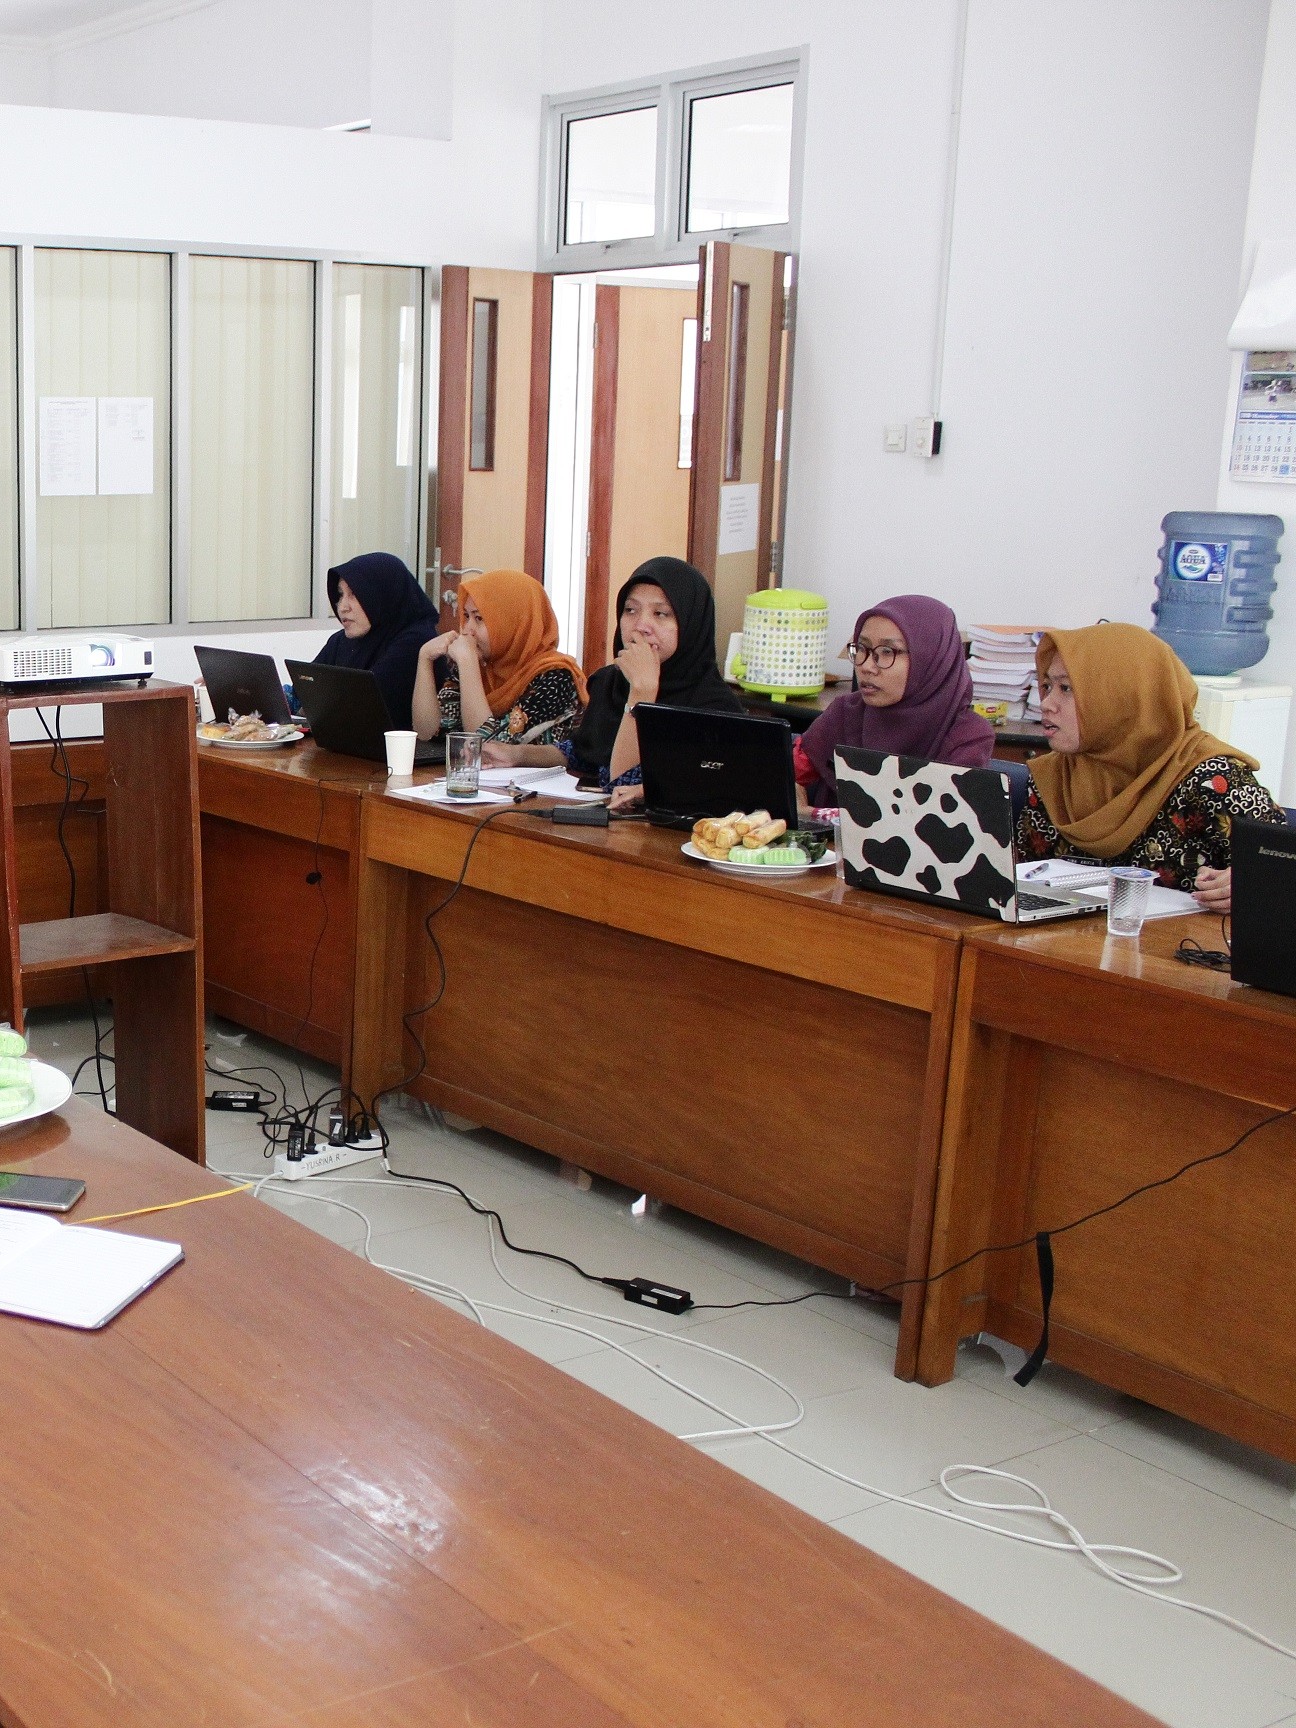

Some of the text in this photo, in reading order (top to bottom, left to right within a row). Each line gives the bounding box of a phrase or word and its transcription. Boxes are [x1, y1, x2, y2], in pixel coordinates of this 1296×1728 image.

[1179, 554, 1206, 564] AQUA
[700, 760, 724, 770] acer
[1258, 846, 1296, 860] lenov
